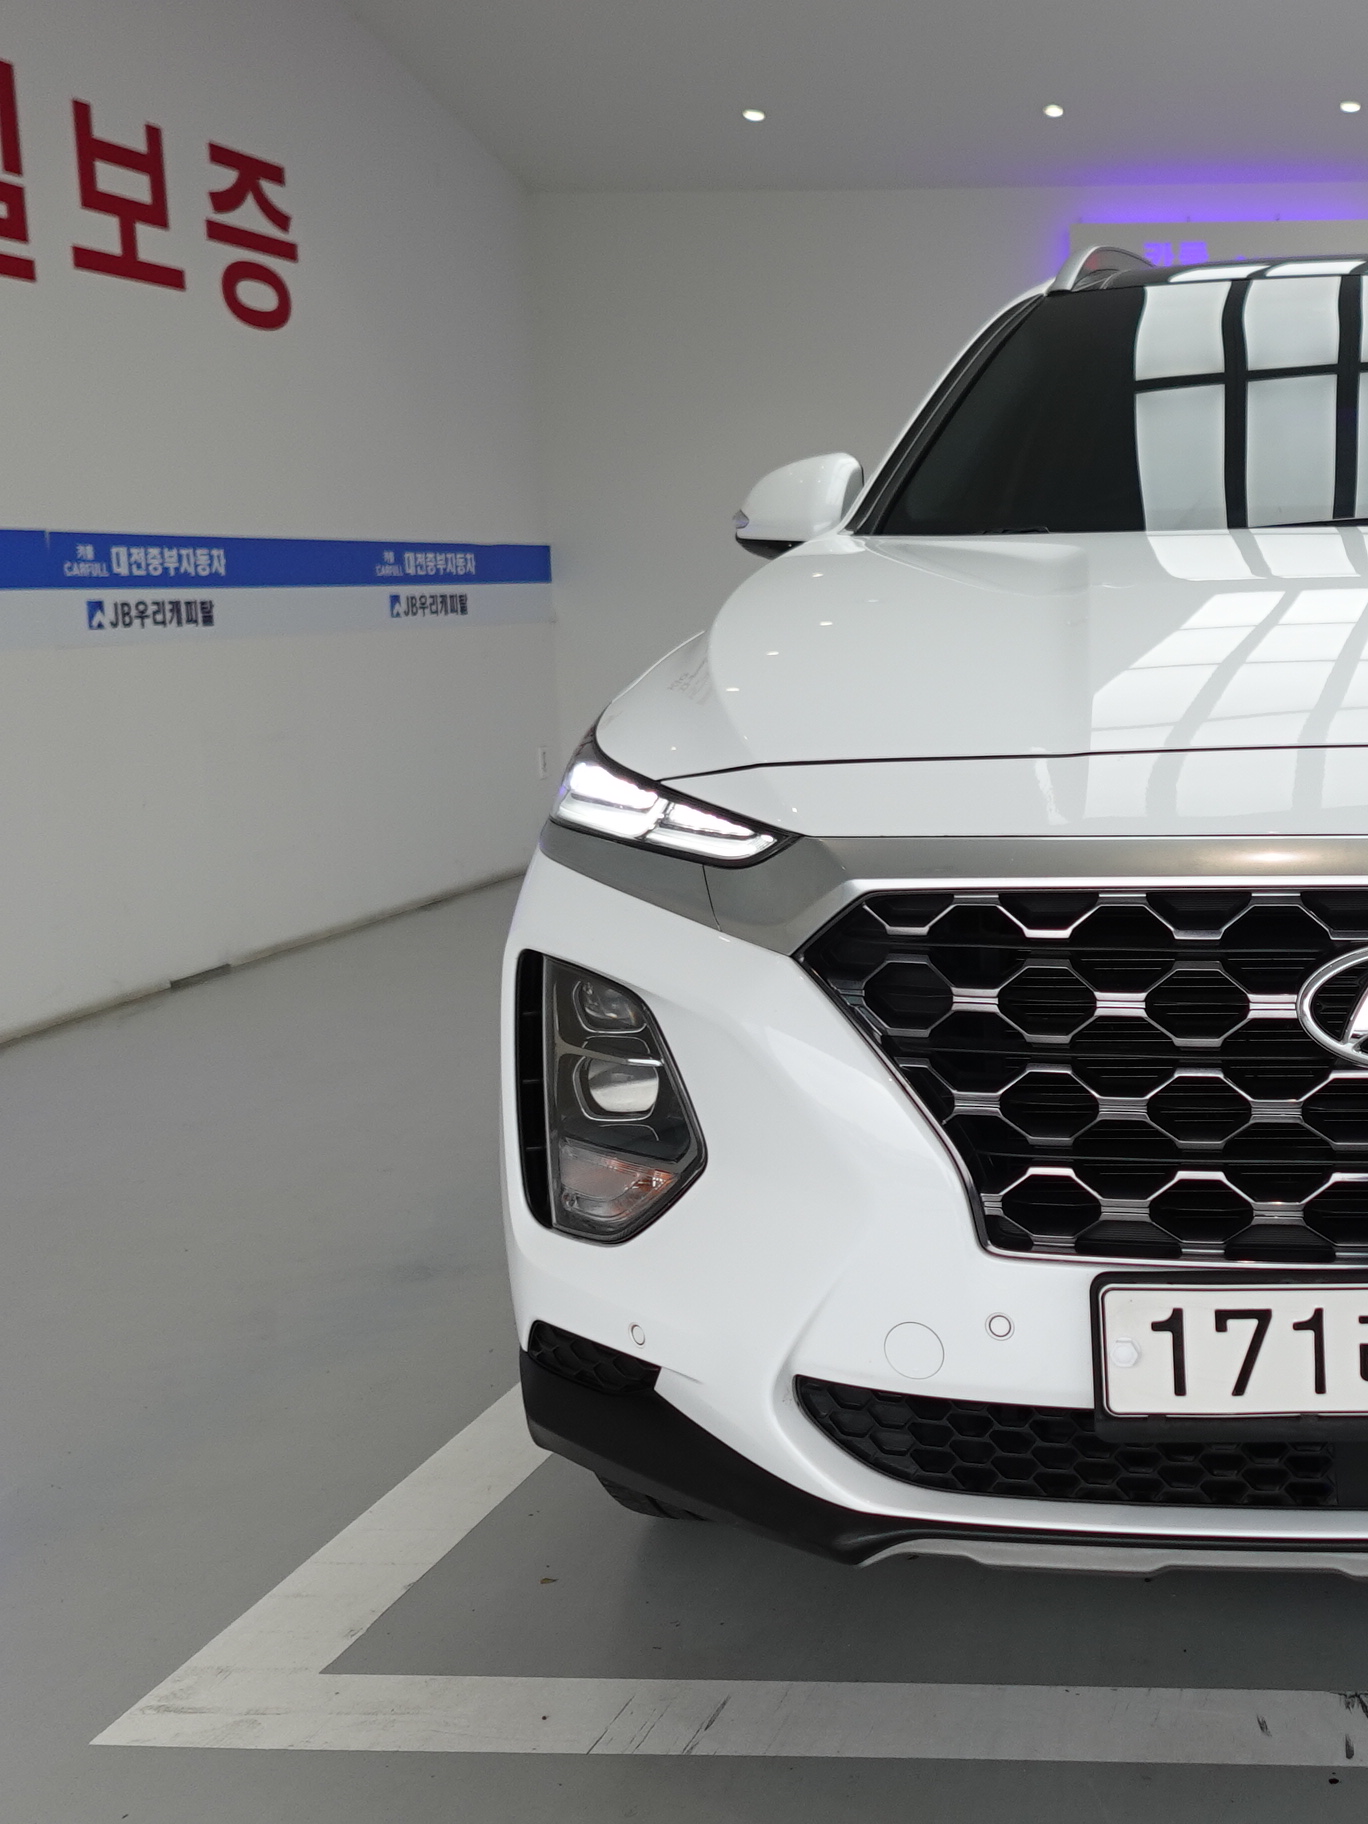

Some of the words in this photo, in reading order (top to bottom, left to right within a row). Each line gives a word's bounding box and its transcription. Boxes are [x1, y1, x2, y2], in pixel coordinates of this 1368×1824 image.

[110, 545, 227, 577] 대전중부자동차
[404, 551, 476, 576] 대전중부자동차
[110, 599, 215, 629] JB우리캐피탈
[403, 594, 468, 617] JB우리캐피탈
